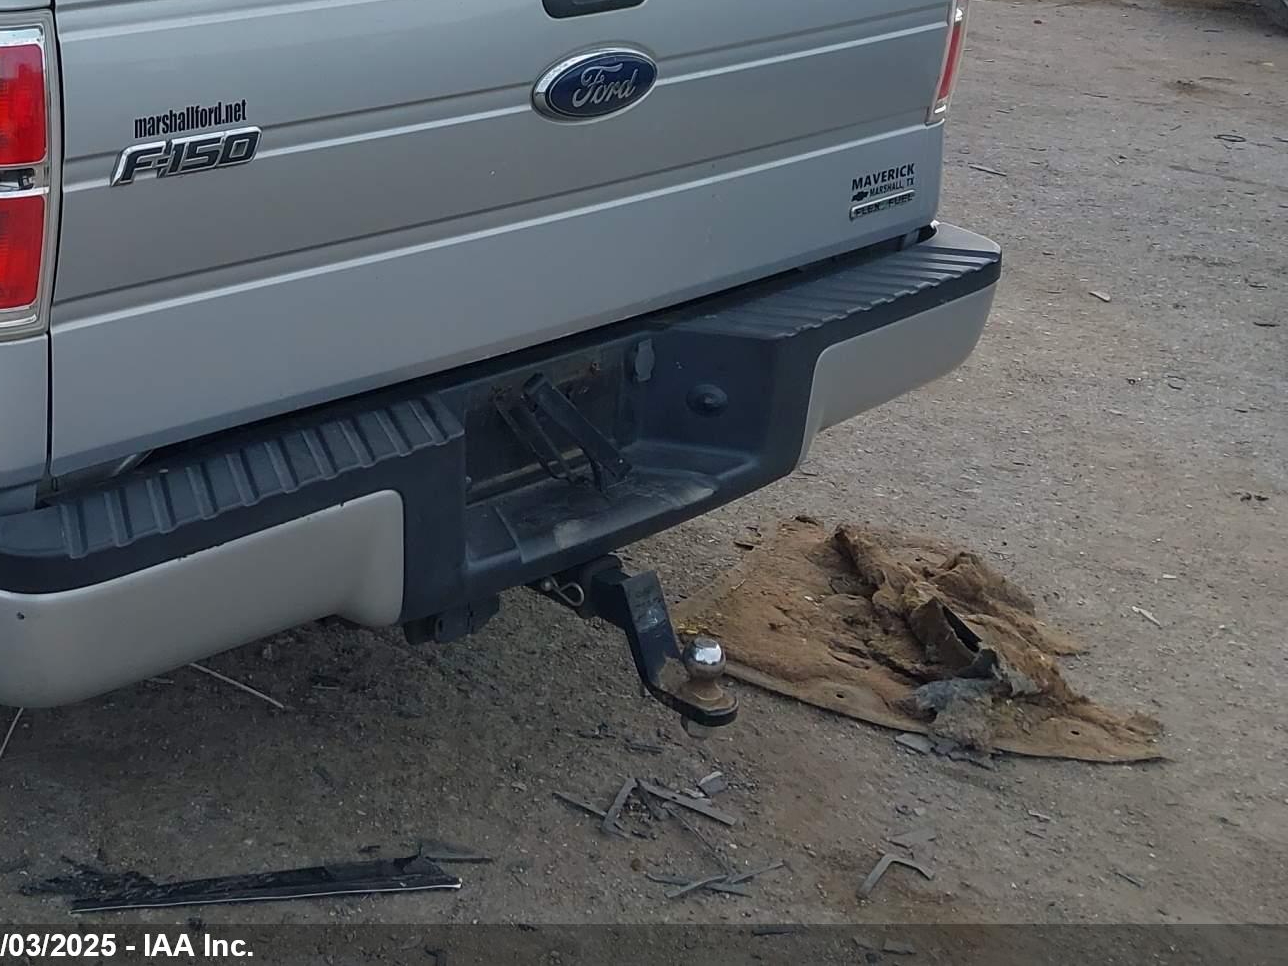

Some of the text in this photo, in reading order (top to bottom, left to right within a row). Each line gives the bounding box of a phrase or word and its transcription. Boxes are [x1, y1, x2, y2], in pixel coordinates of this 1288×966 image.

[572, 62, 638, 108] Ford
[134, 98, 247, 139] marshallford.net
[111, 125, 262, 186] F-150
[852, 163, 915, 191] MAVERICK
[887, 192, 915, 207] FUEL
